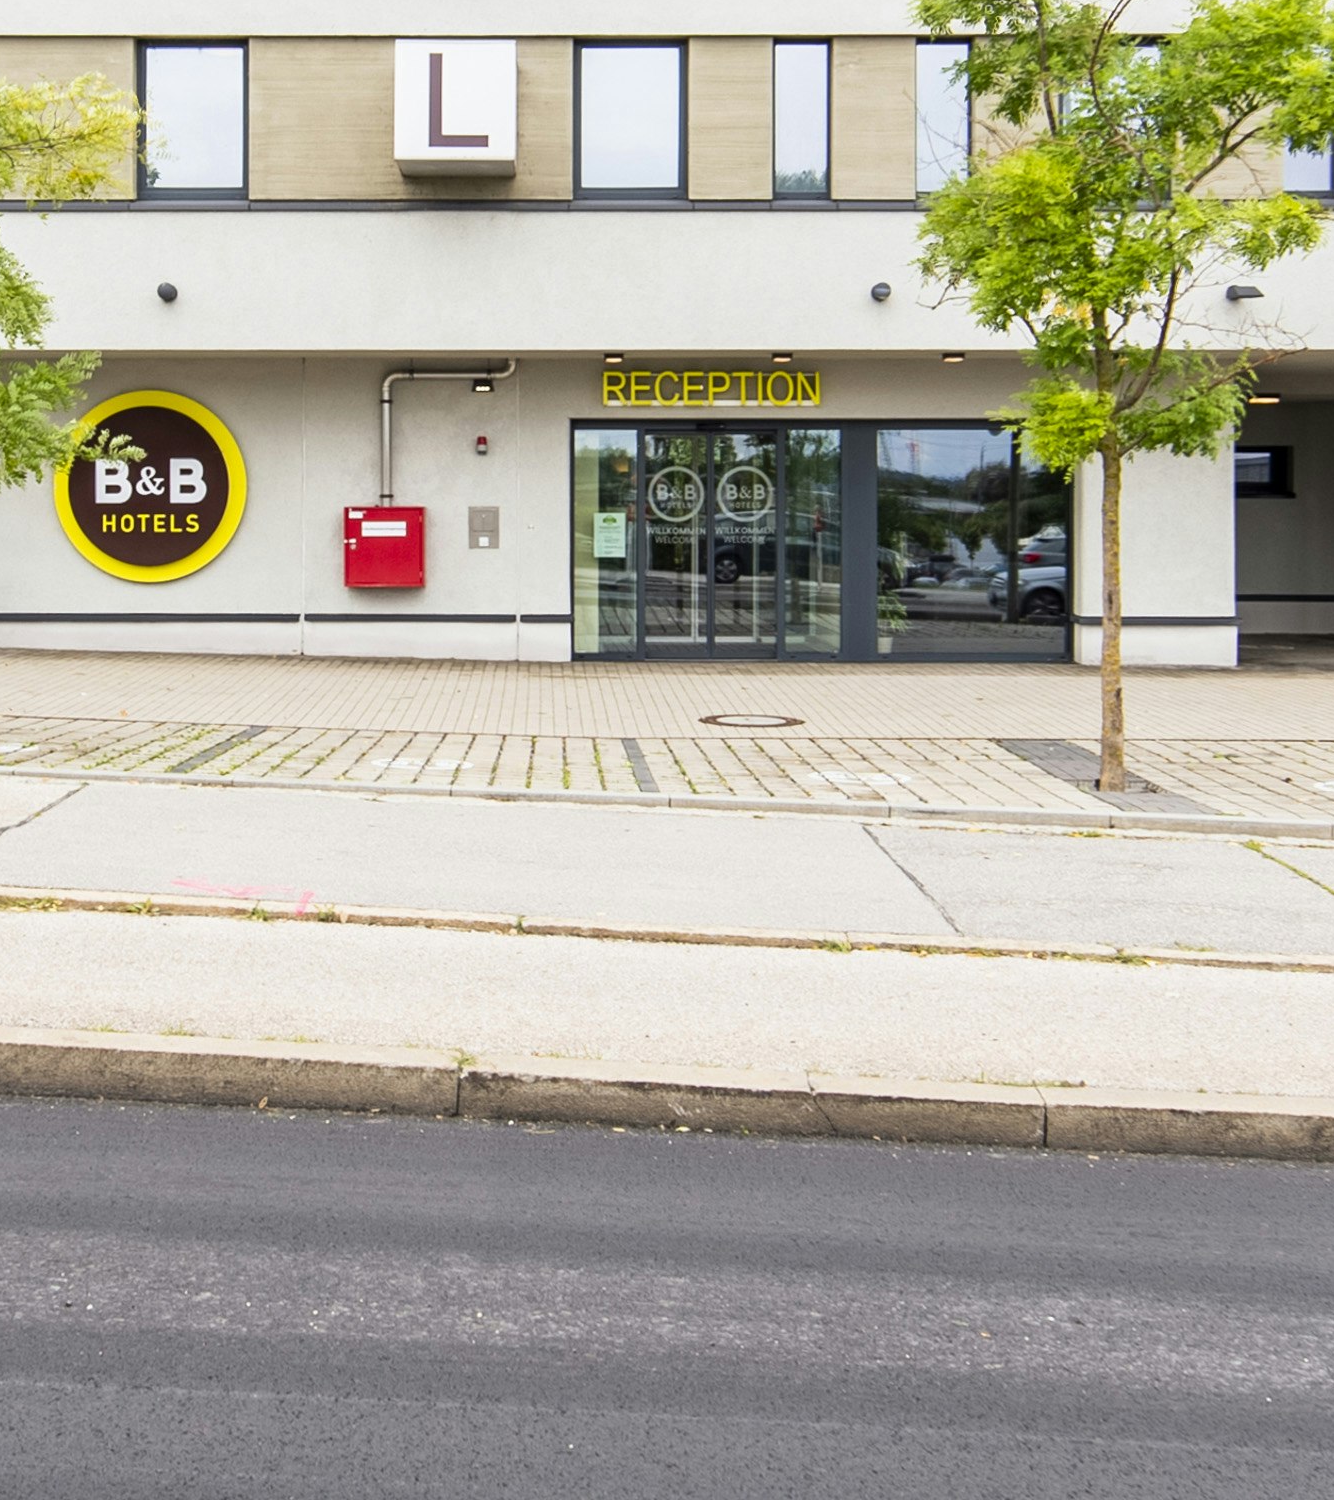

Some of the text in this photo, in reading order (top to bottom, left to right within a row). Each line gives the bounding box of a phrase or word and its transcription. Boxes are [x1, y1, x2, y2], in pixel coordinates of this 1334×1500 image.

[602, 370, 822, 407] RECEPTION
[94, 457, 208, 504] B&B
[656, 484, 697, 501] B&B
[726, 484, 766, 501] B&B
[101, 513, 200, 534] HOTELS
[646, 526, 707, 535] WILLKOMMEN
[714, 526, 775, 535] WILLKOMMEN
